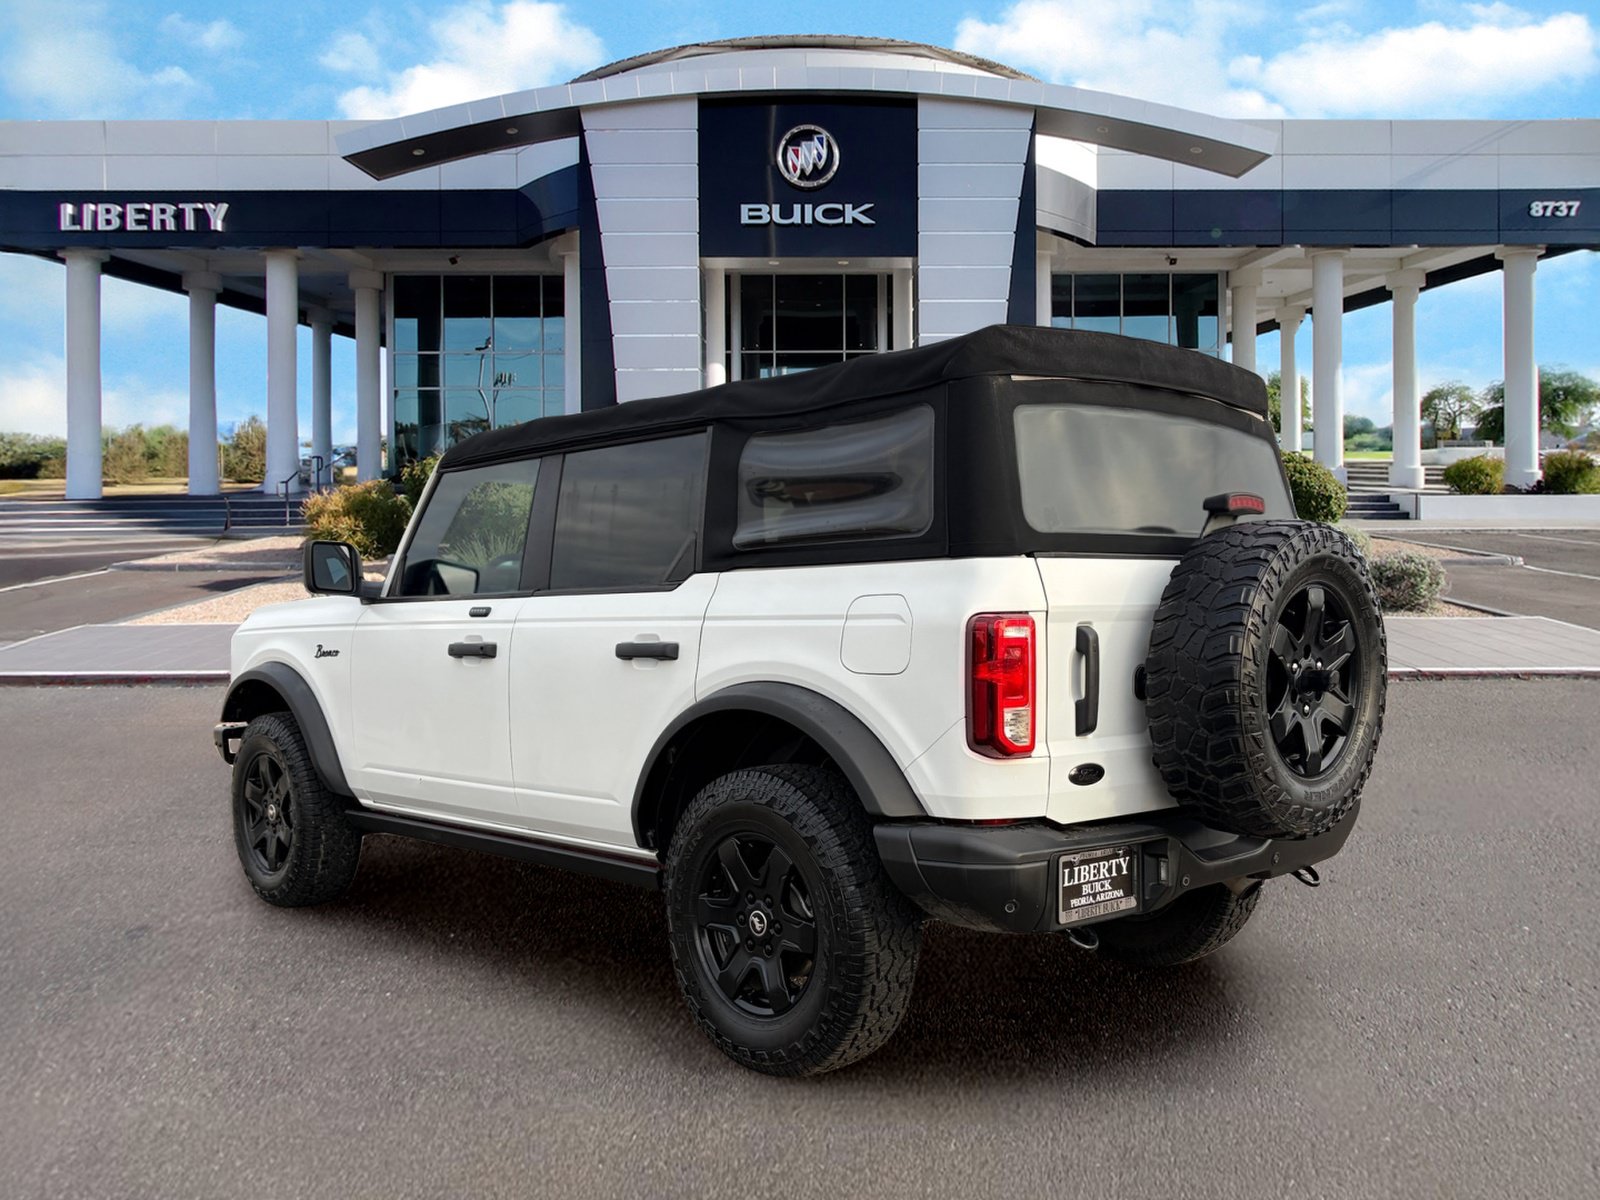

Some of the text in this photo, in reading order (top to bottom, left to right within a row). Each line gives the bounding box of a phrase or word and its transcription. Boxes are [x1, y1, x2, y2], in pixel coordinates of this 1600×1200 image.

[58, 203, 229, 231] LIBERTY
[740, 203, 876, 224] BUICK
[1529, 201, 1581, 217] 8737
[1063, 857, 1130, 887] LIBERTY
[1082, 880, 1112, 895] BUICK
[1096, 888, 1124, 902] ARIZONA
